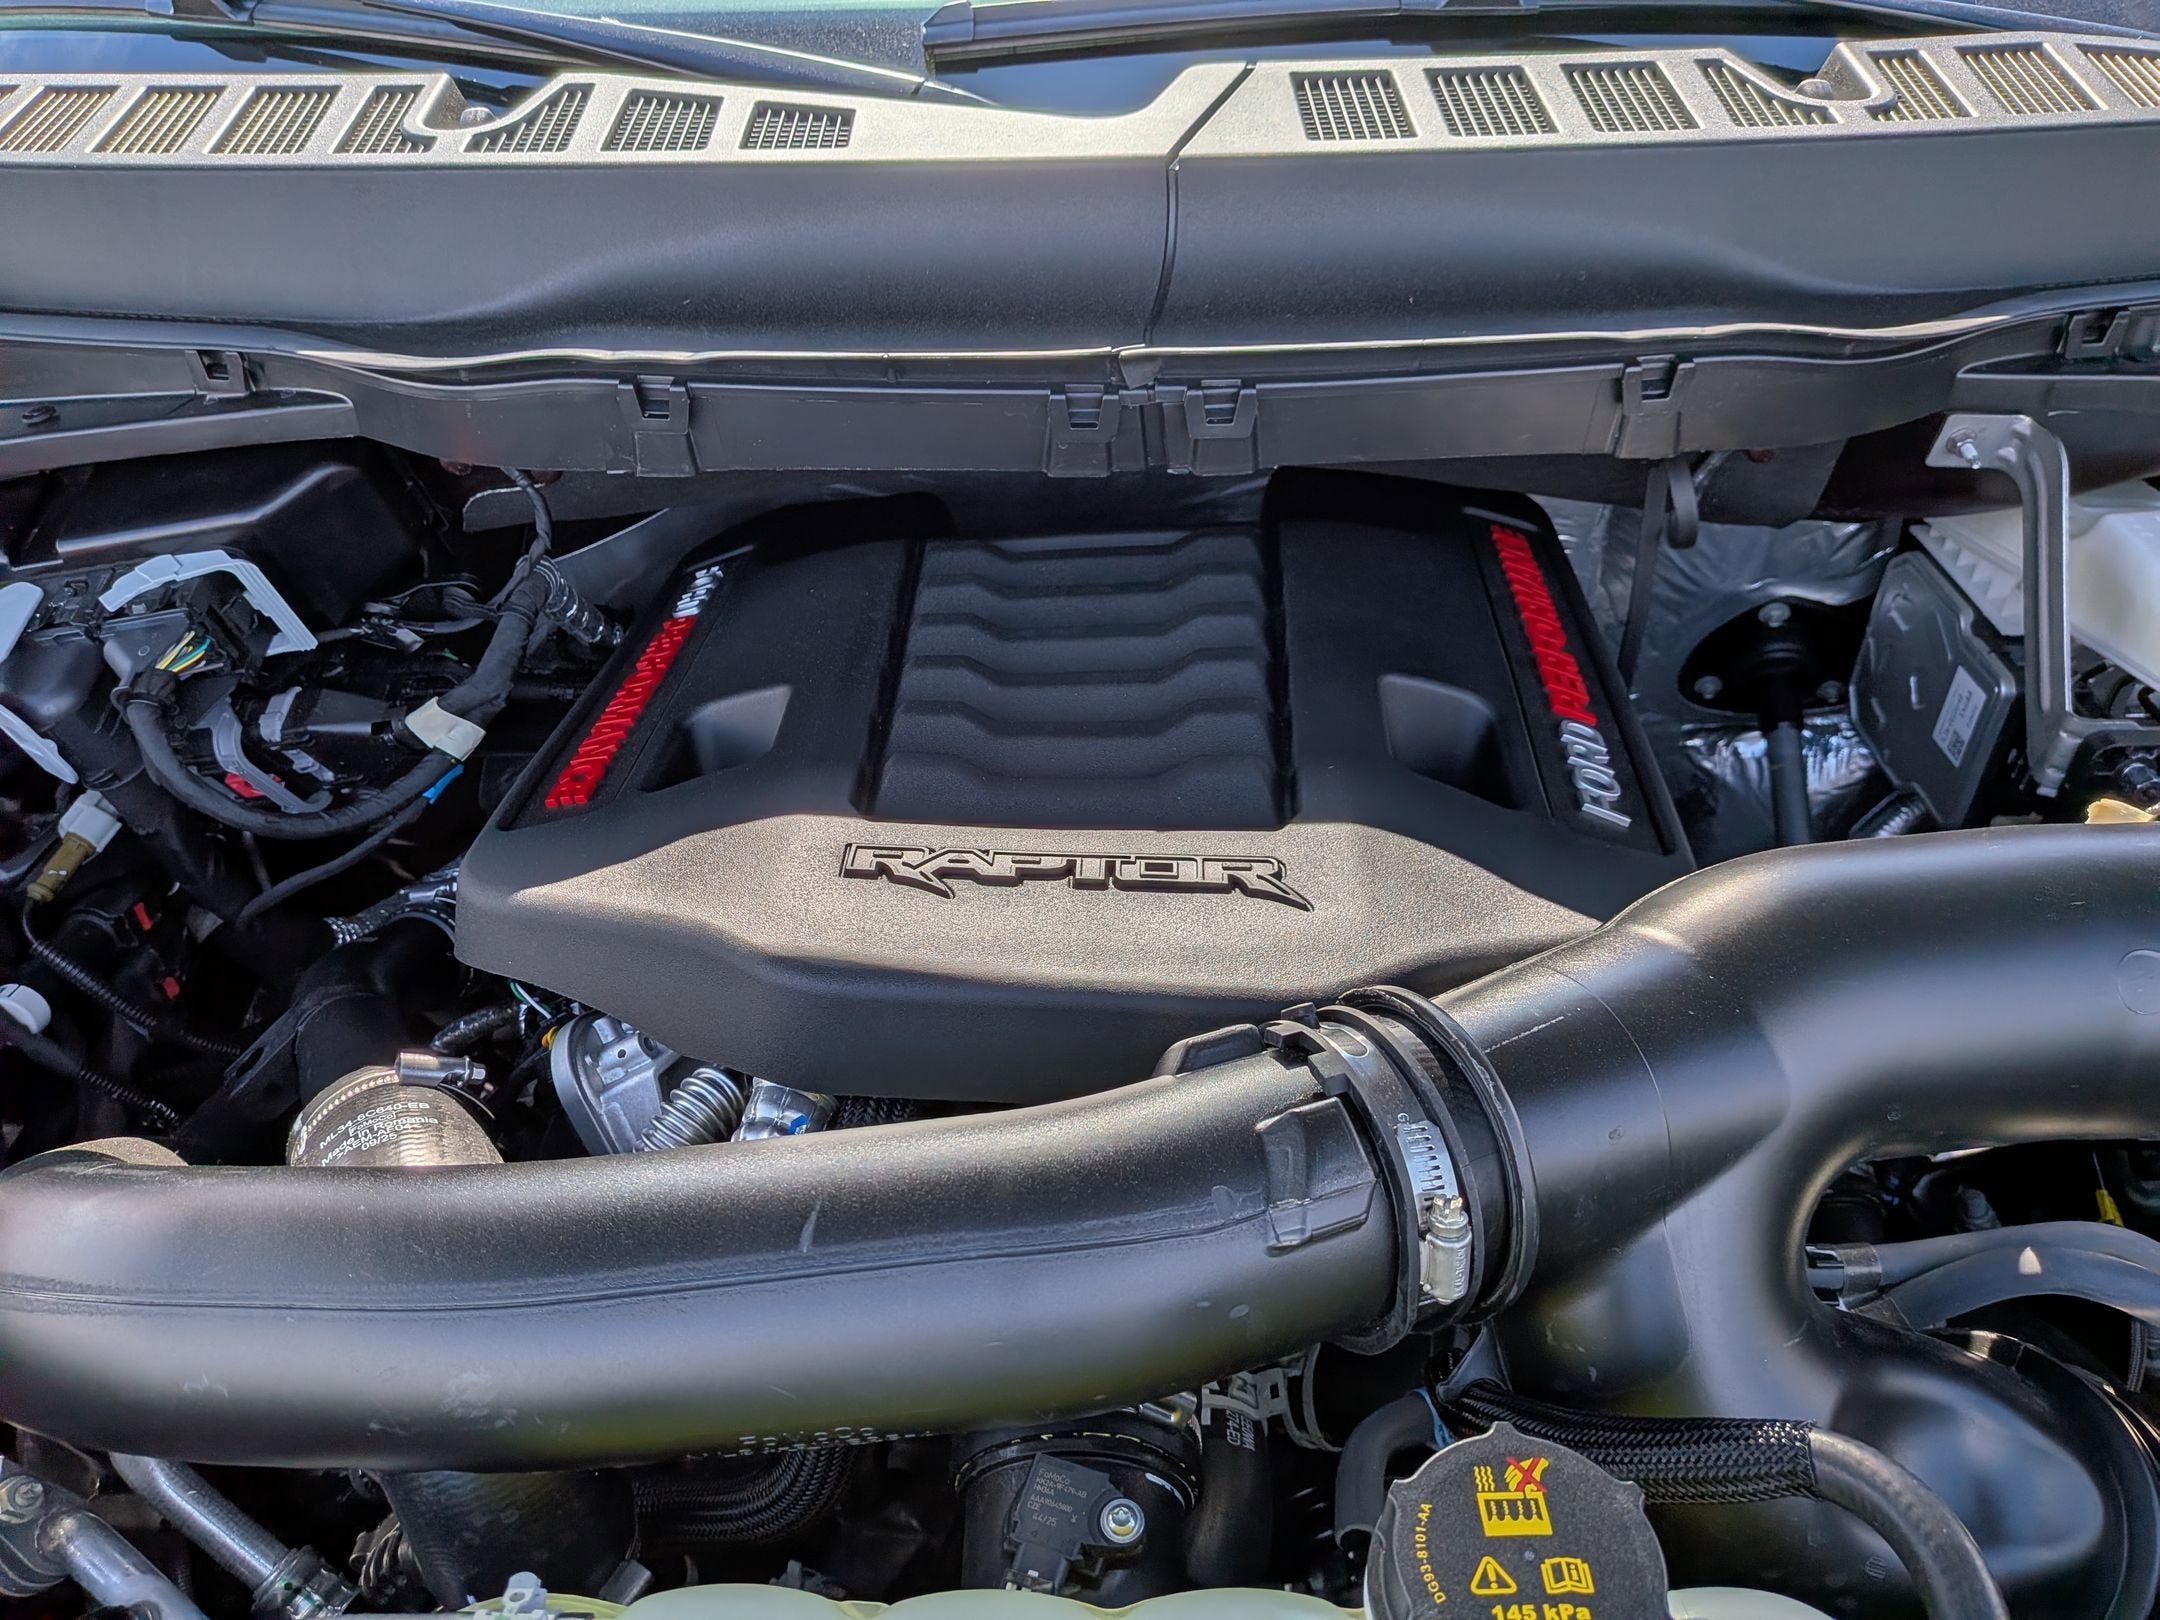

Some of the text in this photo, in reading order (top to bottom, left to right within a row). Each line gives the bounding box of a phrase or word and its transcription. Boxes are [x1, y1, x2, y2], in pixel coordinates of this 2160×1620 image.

[1489, 524, 1632, 828] FORD PERFORMANCE
[544, 615, 696, 808] PERFORMANCE
[839, 842, 1314, 912] RAPTOR
[320, 1102, 430, 1150] ML34-6C640-EB
[321, 1116, 439, 1167] Made in Romania
[361, 1132, 398, 1150] 09/25
[1038, 1468, 1071, 1485] FoMoCo
[1415, 1503, 1447, 1604] DG93-8101-AA
[1491, 1603, 1592, 1620] 145 kPa
